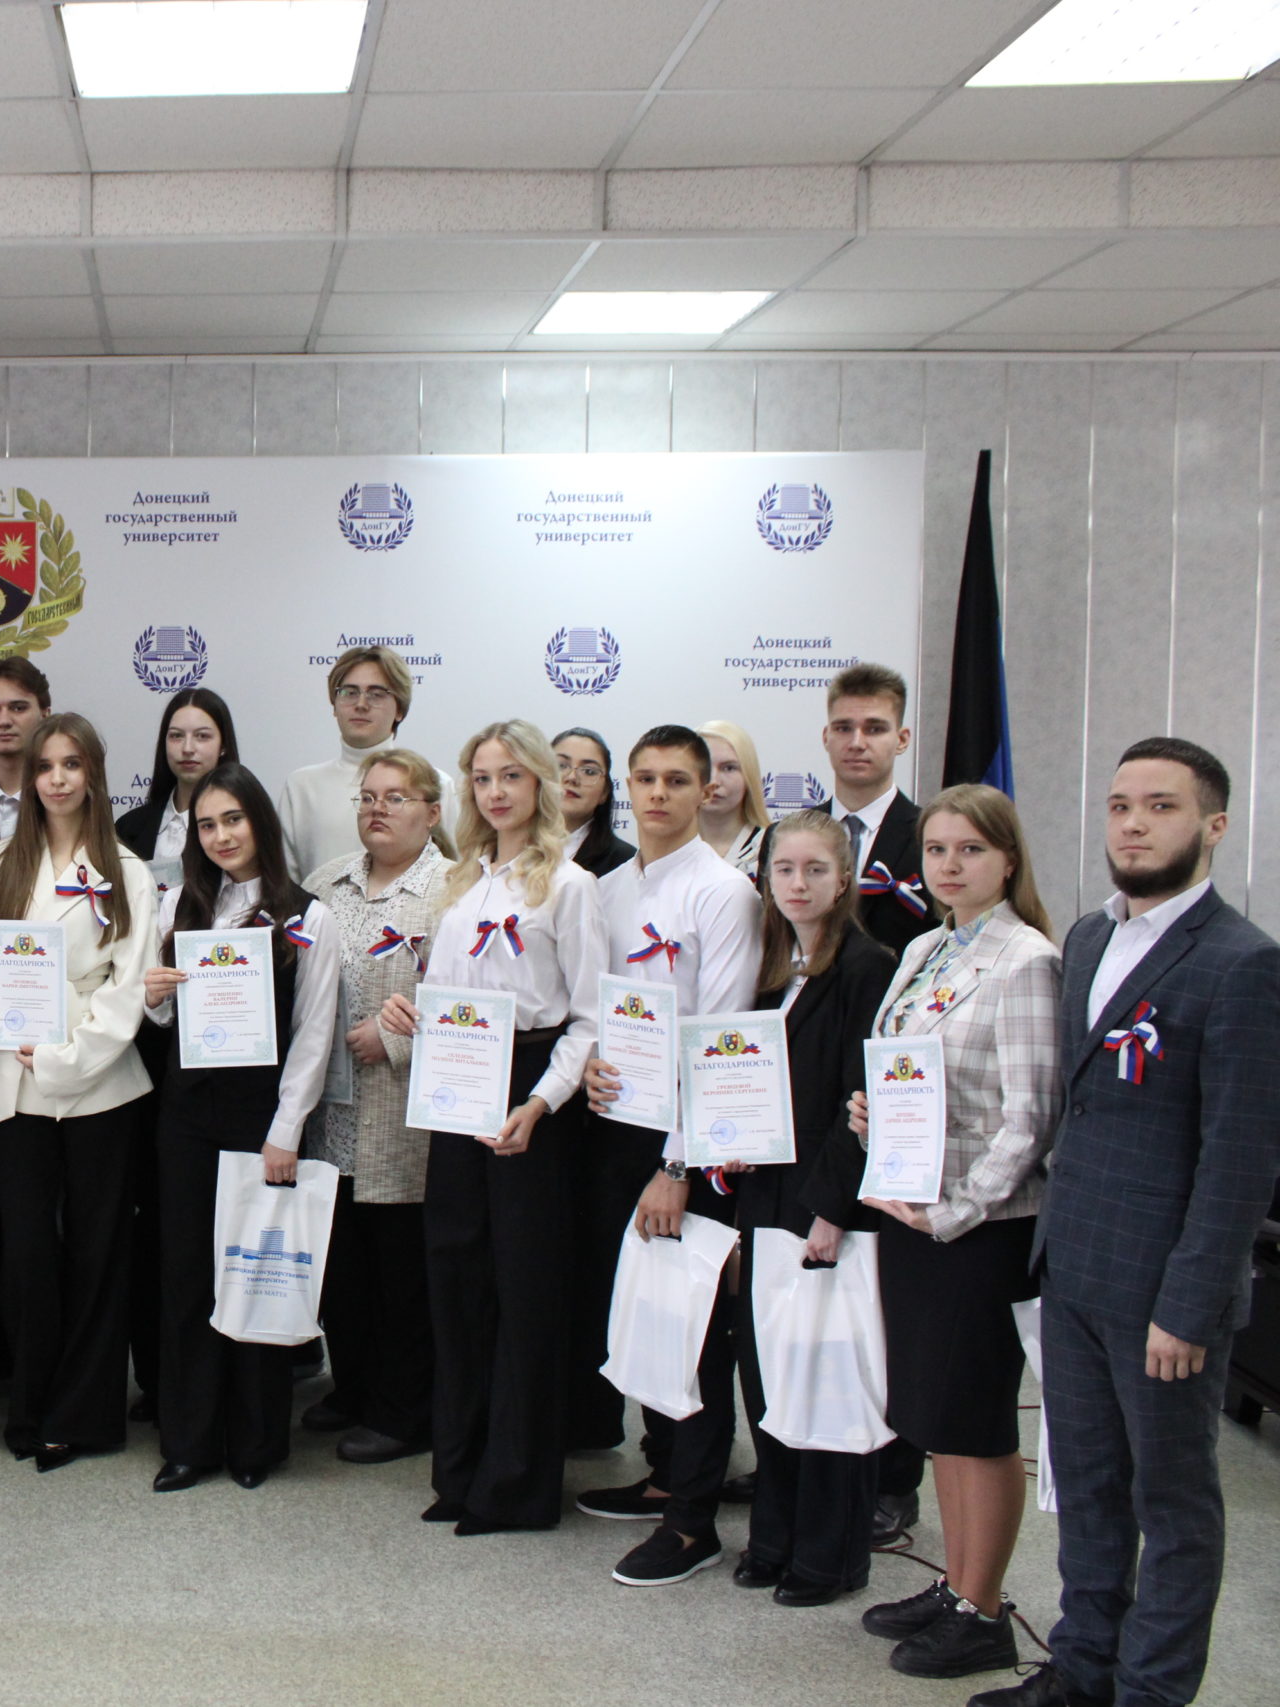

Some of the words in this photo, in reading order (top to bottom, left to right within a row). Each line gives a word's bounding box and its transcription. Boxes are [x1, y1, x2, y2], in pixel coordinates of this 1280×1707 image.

[133, 491, 210, 506] Донецкий
[545, 490, 624, 504] Донецкий
[105, 510, 238, 527] государственный
[516, 510, 653, 526] государственный
[361, 521, 392, 531] ДонГУ
[123, 532, 220, 546] университет
[535, 531, 634, 545] университет
[337, 633, 415, 648] Донецкий
[753, 635, 832, 650] Донецкий
[154, 664, 186, 673] ДонГУ
[567, 665, 599, 675] ДонГУ
[743, 677, 832, 691] университе
[188, 969, 260, 980] БЛАГОДАРНОСТЬ
[606, 1017, 666, 1036] БЛАГОДАРНОСТЬ
[426, 1028, 500, 1043] БЛАГОДАРНОСТЬ
[693, 1058, 774, 1071] БЛАГОДАРНОСТЬ
[876, 1085, 935, 1096] БЛАГОДАРНОСТЬ
